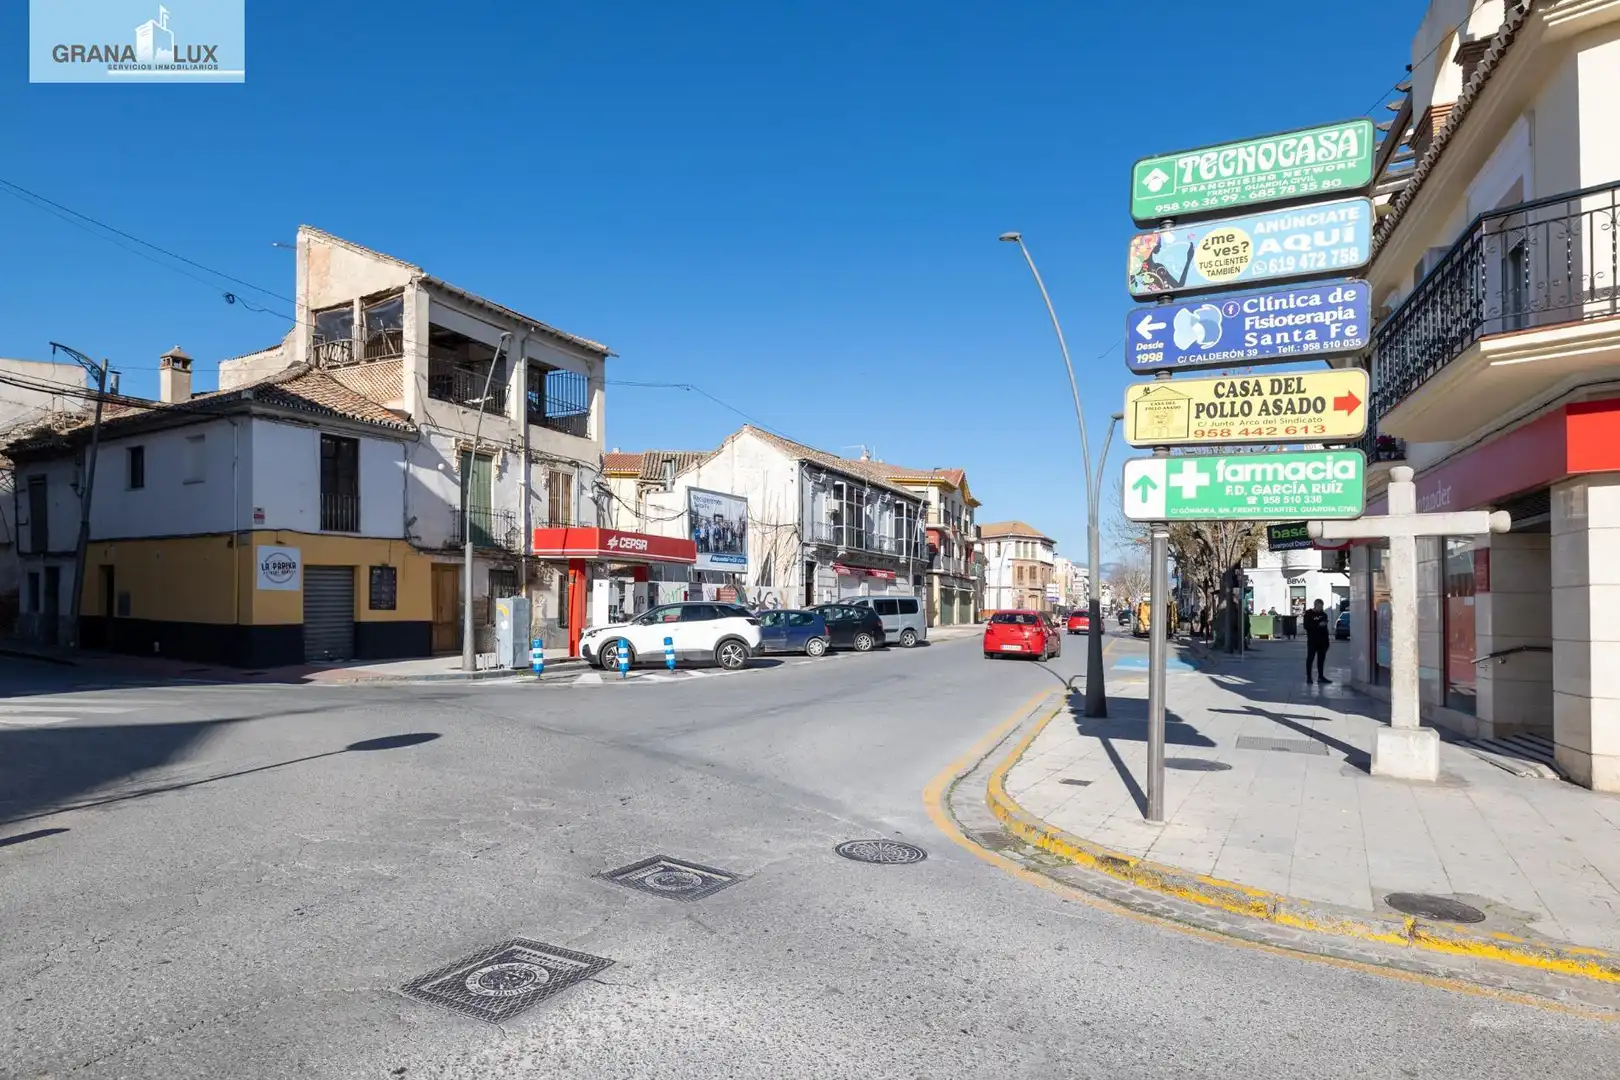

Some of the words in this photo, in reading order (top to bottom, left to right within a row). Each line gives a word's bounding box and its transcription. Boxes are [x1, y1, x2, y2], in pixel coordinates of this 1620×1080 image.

[1178, 128, 1359, 183] TECNOCASA
[1181, 174, 1277, 194] FRANCHISING
[1283, 161, 1357, 178] NETWORK
[1207, 187, 1241, 197] FRENTE
[1245, 179, 1289, 191] GUARDIA
[1290, 175, 1315, 184] CIVIL
[1154, 203, 1179, 213] 958
[1182, 200, 1199, 209] 96
[1201, 197, 1218, 206] 36
[1221, 194, 1239, 203] 99
[1248, 188, 1276, 199] 685
[1280, 185, 1296, 194] 78
[1300, 181, 1318, 191] 35
[1321, 178, 1342, 188] 80
[1253, 207, 1361, 234] ANÚNCIATE
[1202, 233, 1235, 250] ¿me
[1213, 241, 1249, 257] ves?
[1256, 220, 1357, 256] AQUÍ
[1198, 260, 1213, 269] TUS
[1214, 256, 1249, 268] CLIENTES
[1206, 265, 1241, 277] TAMBIÉN
[1268, 256, 1296, 273] 619
[1299, 251, 1326, 270] 472
[1330, 247, 1359, 265] 758
[1243, 294, 1322, 313] Clínica
[1328, 287, 1357, 302] de
[1245, 307, 1356, 331] Fisioterapia
[1136, 341, 1164, 351] Desde
[1245, 328, 1318, 347] Santa
[1330, 323, 1358, 338] Fe
[1136, 352, 1164, 363] 1998
[1177, 355, 1188, 364] C/
[1189, 349, 1245, 362] CALDERÓN
[1247, 348, 1258, 357] 39
[1302, 343, 1320, 351] 958
[1323, 340, 1341, 349] 510
[1343, 338, 1361, 347] 035
[1213, 380, 1264, 399] CASA
[1269, 376, 1307, 396] DEL
[1194, 400, 1251, 419] POLLO
[1258, 396, 1326, 417] ASADO
[1193, 428, 1232, 438] 958
[1238, 427, 1277, 436] 442
[1285, 424, 1327, 435] 613
[1210, 420, 1235, 428] Junto
[1280, 416, 1323, 424] Sindicato
[1216, 455, 1356, 483] farmacia
[1251, 481, 1308, 495] GARCÍA
[1311, 480, 1344, 494] RUÍZ
[1416, 479, 1452, 514] ntander
[1263, 495, 1281, 504] 958
[1283, 495, 1301, 504] 510
[1271, 526, 1308, 539] base
[619, 537, 648, 551] CEPSA
[1270, 541, 1295, 550] Liverpool
